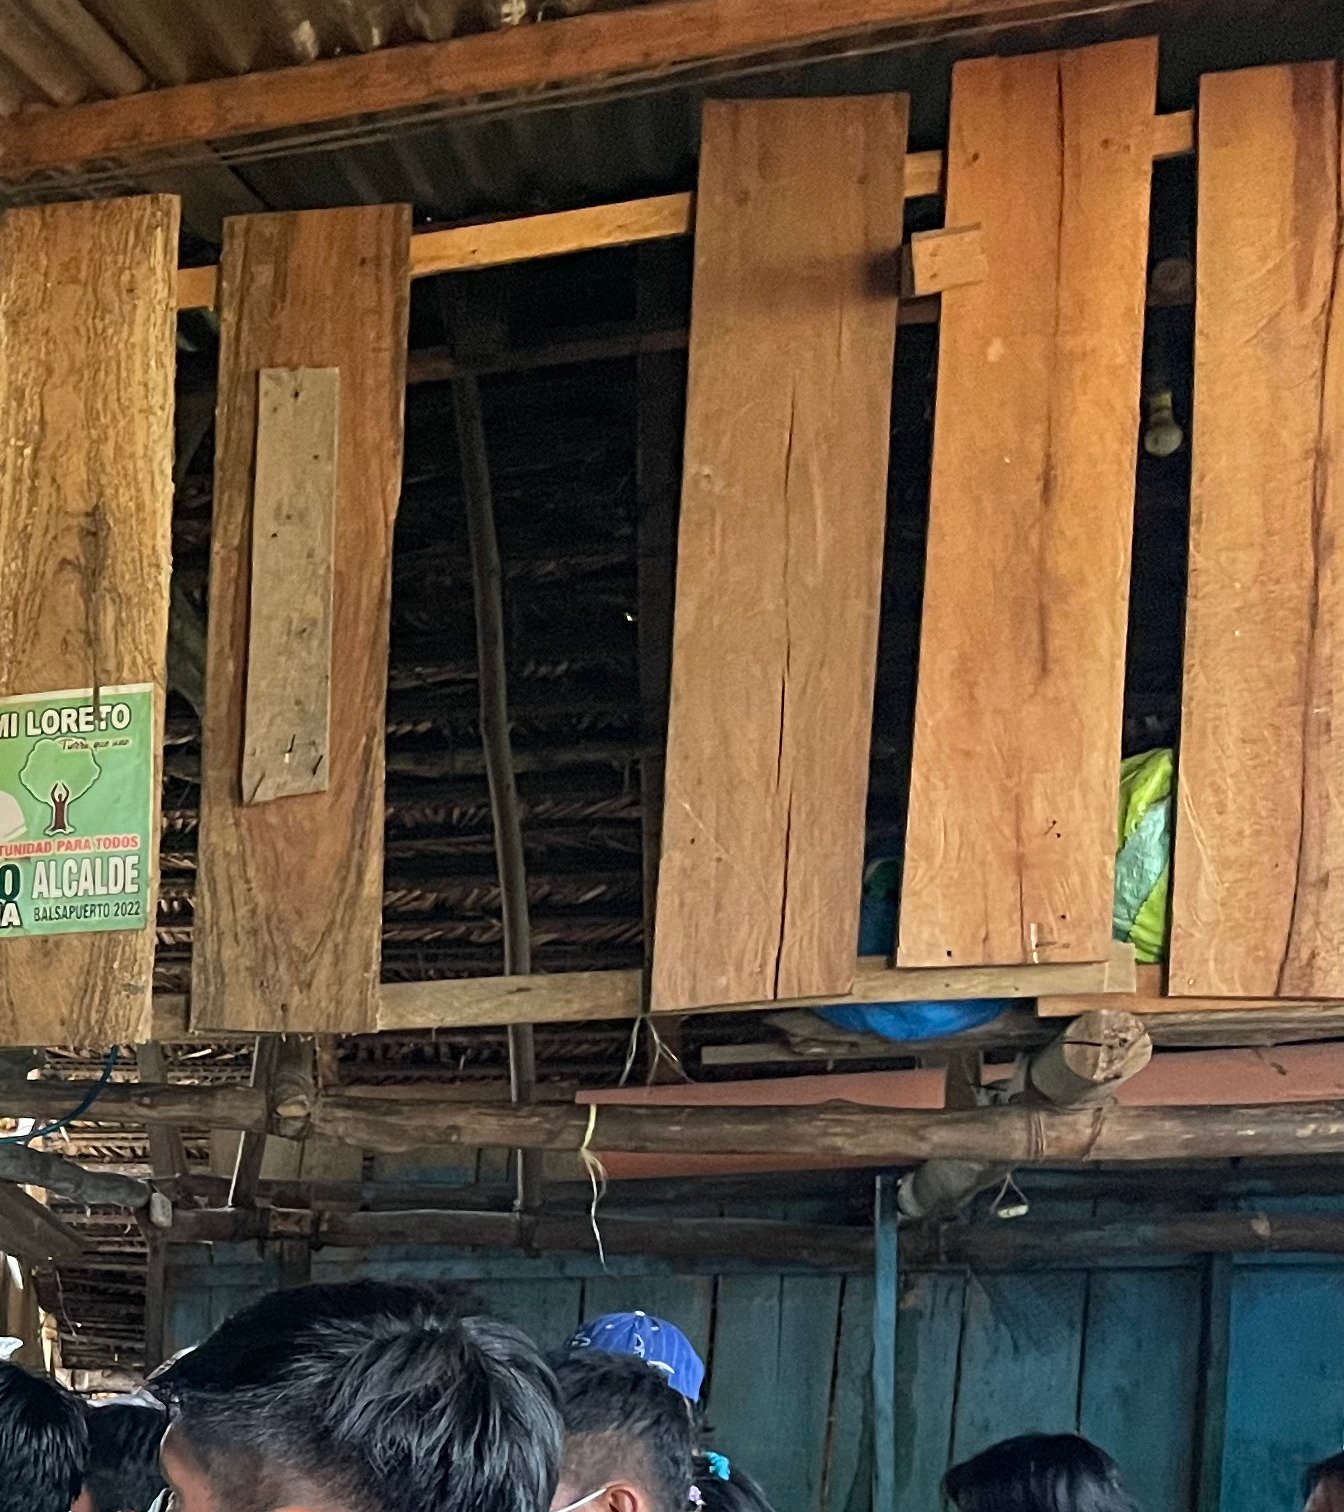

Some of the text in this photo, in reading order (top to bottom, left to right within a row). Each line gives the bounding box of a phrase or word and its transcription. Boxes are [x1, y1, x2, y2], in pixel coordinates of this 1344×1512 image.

[26, 702, 132, 737] LORETO
[57, 838, 92, 853] PARA
[95, 835, 139, 850] TODOS
[31, 854, 141, 899] ALCALDE
[33, 901, 141, 922] BALSAPUERTO 2022
